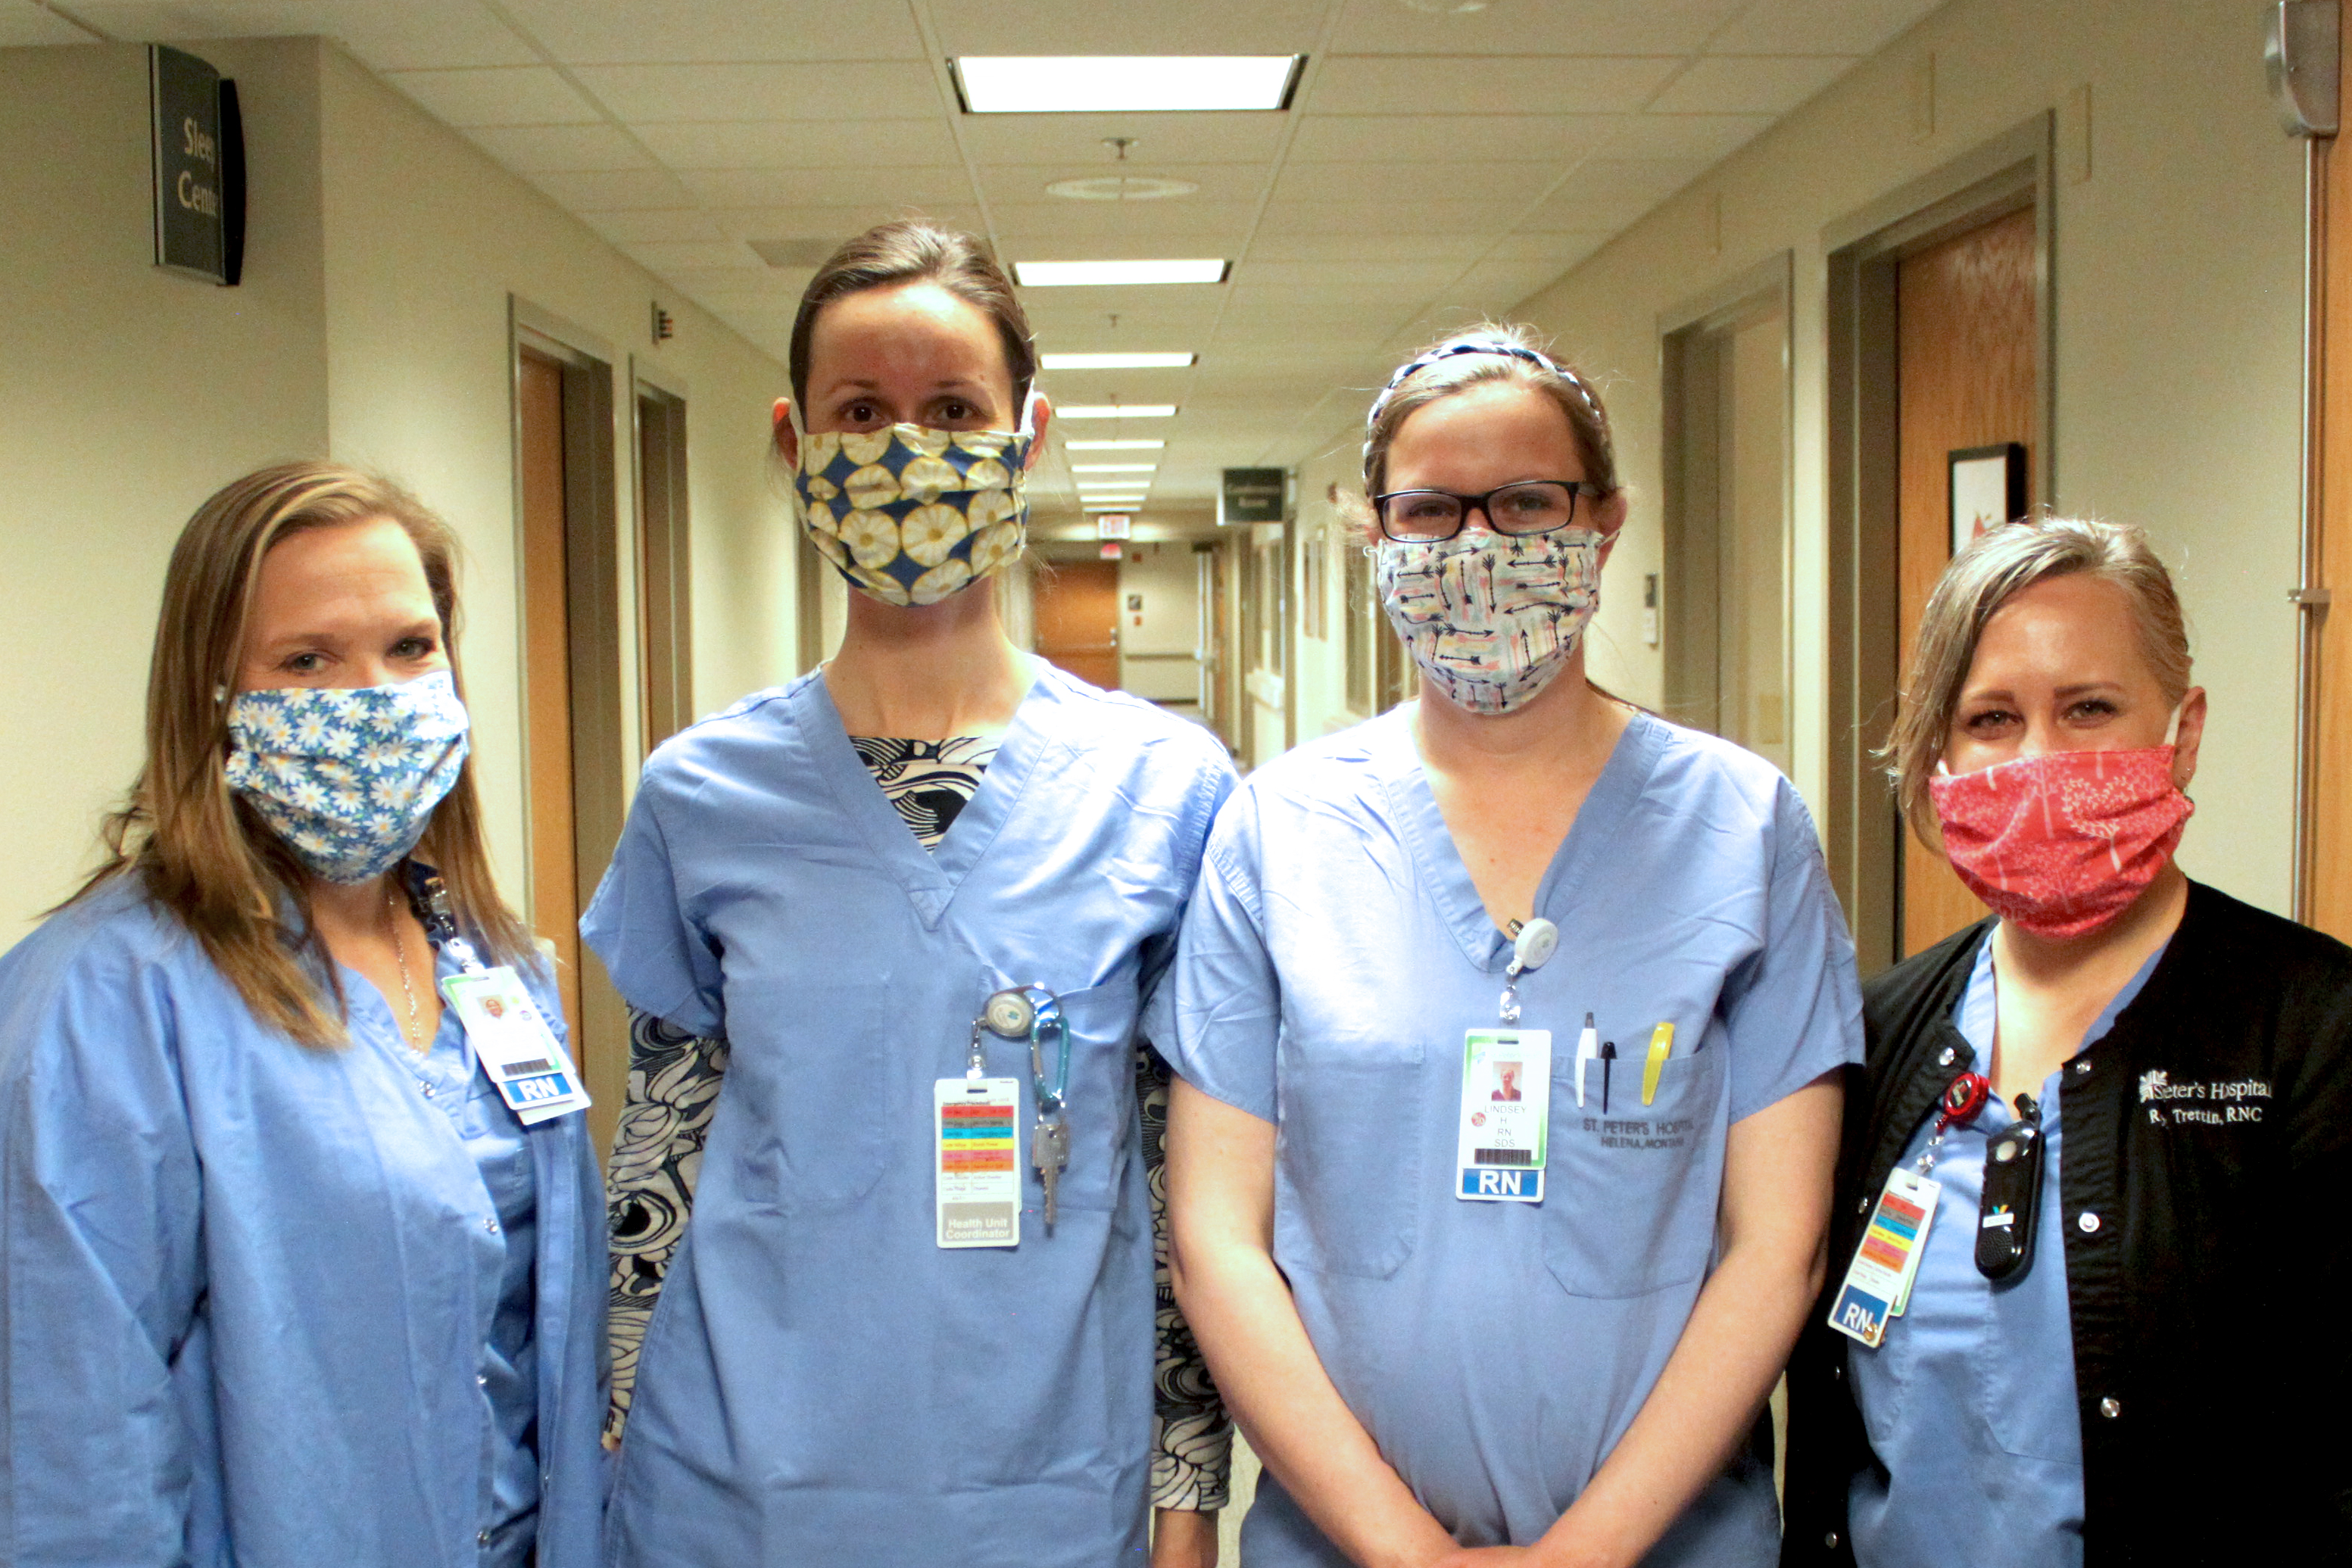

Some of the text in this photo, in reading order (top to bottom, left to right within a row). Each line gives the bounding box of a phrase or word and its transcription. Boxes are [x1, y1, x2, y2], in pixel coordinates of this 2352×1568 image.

[518, 1077, 559, 1100] RN
[1484, 1105, 1527, 1114] LINDSEY
[2226, 1106, 2263, 1122] RNC
[1494, 1139, 1515, 1148] SDS
[1479, 1171, 1521, 1195] RN
[948, 1217, 1008, 1229] Health Unit
[946, 1228, 1011, 1239] Coordinator
[1842, 1302, 1874, 1333] RN
